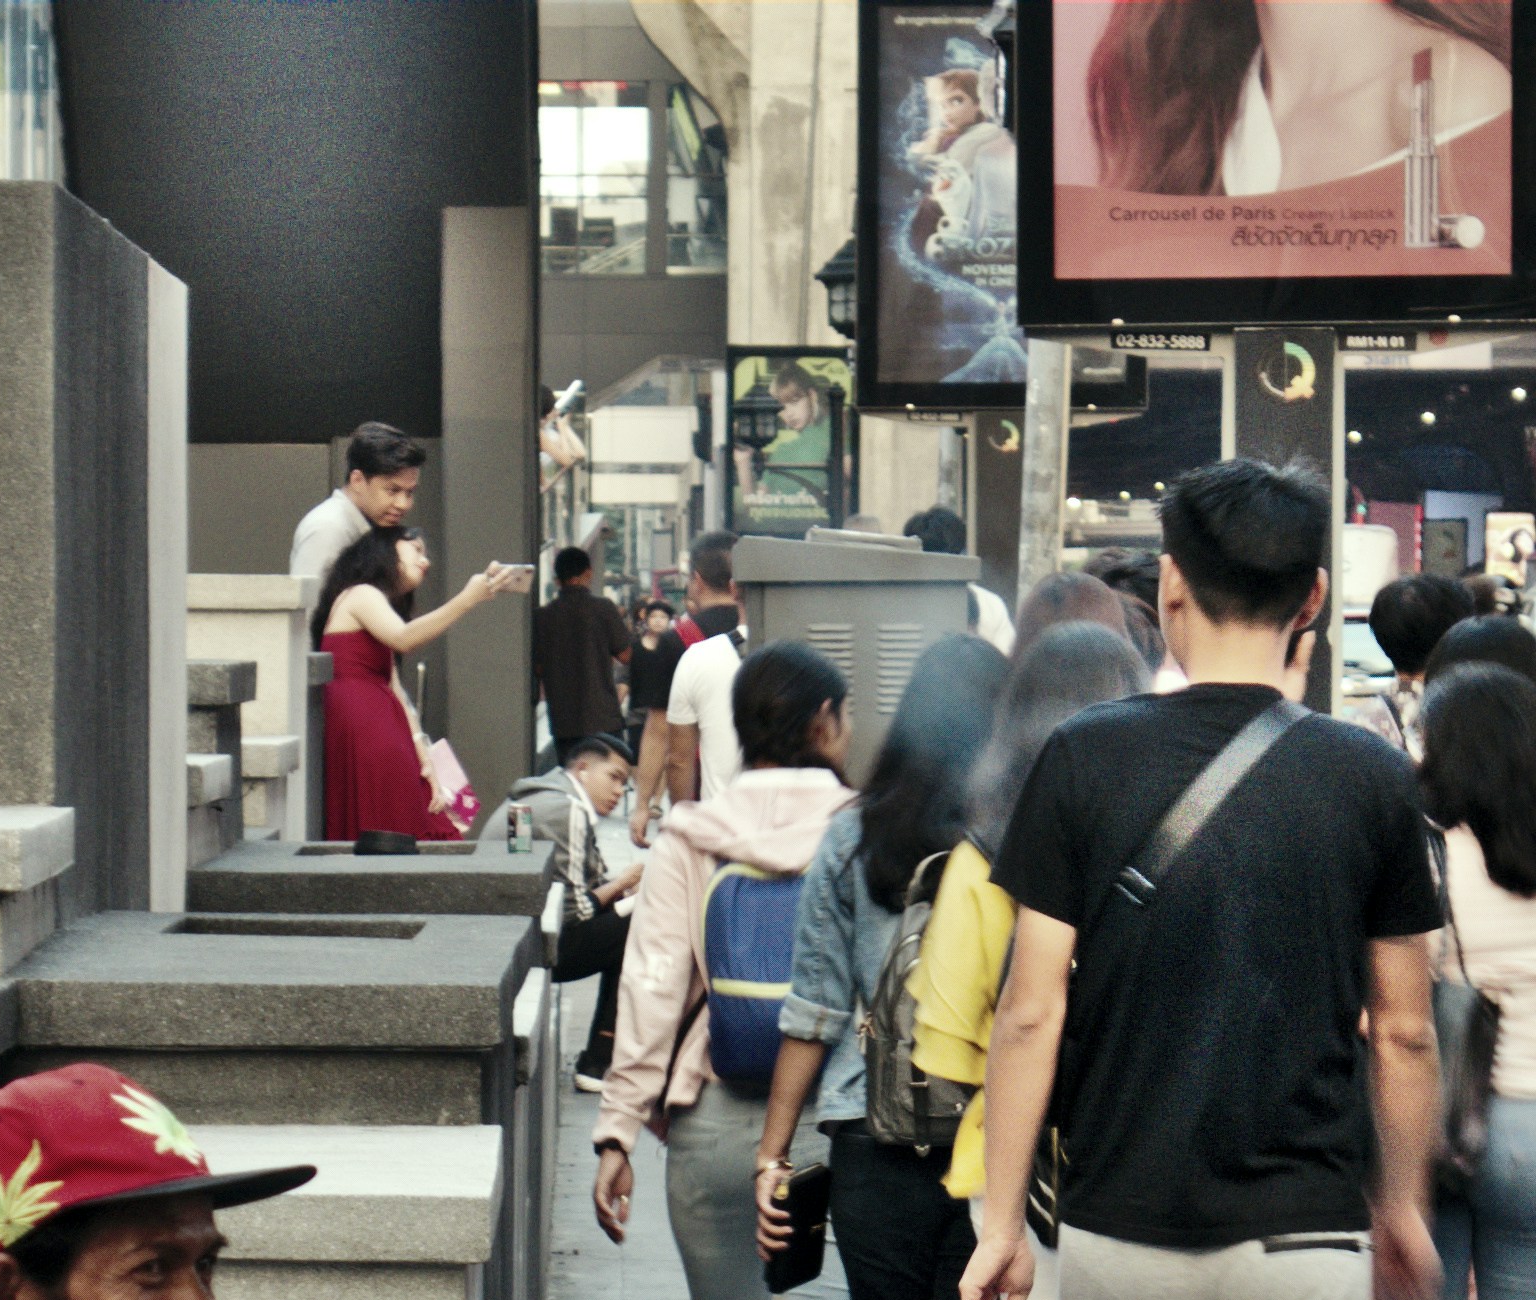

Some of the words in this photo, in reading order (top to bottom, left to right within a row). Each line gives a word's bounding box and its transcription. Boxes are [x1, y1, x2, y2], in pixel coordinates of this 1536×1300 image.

[1108, 206, 1196, 221] Carrousel
[1202, 206, 1226, 221] de
[1231, 205, 1276, 221] Paris
[1281, 208, 1334, 222] Creamy
[1339, 207, 1395, 221] Lipstick
[1116, 334, 1205, 349] 02-832-5888
